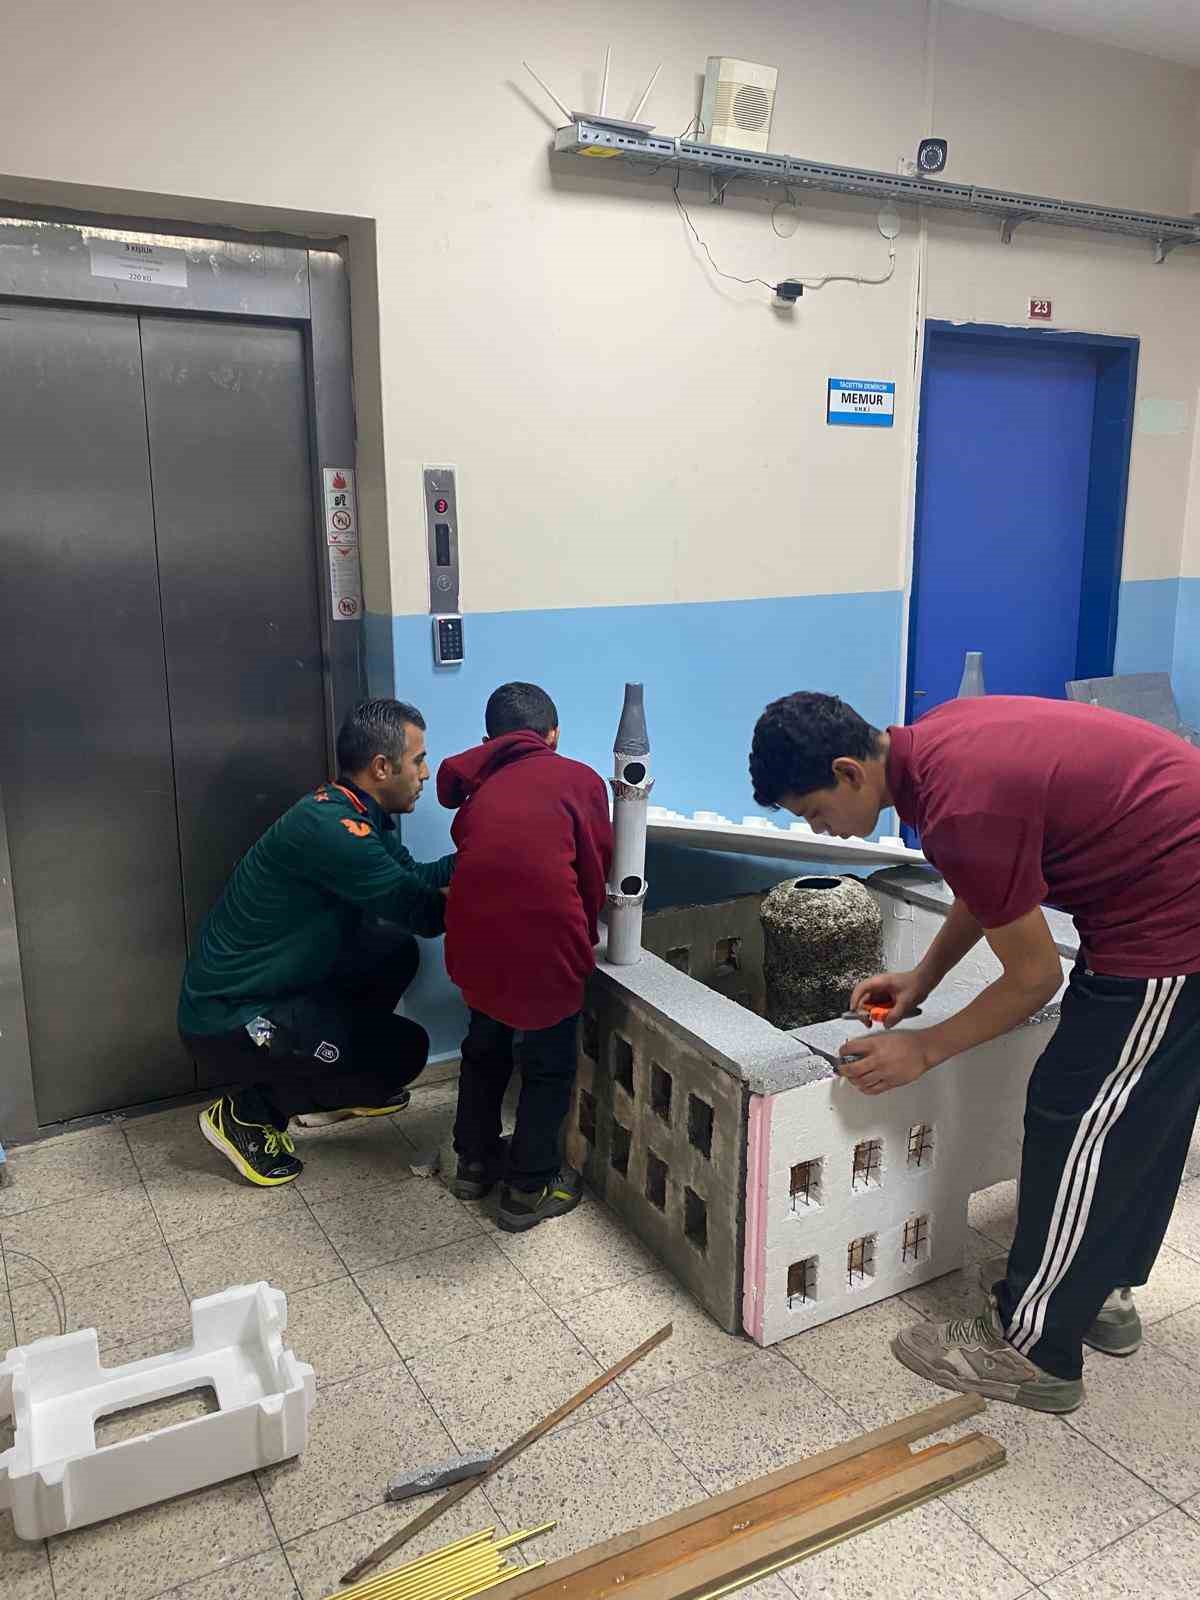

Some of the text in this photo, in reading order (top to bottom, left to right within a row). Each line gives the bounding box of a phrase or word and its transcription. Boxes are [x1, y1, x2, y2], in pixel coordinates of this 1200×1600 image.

[128, 272, 142, 281] 220
[1034, 301, 1048, 314] 23
[841, 392, 883, 406] MEMUR
